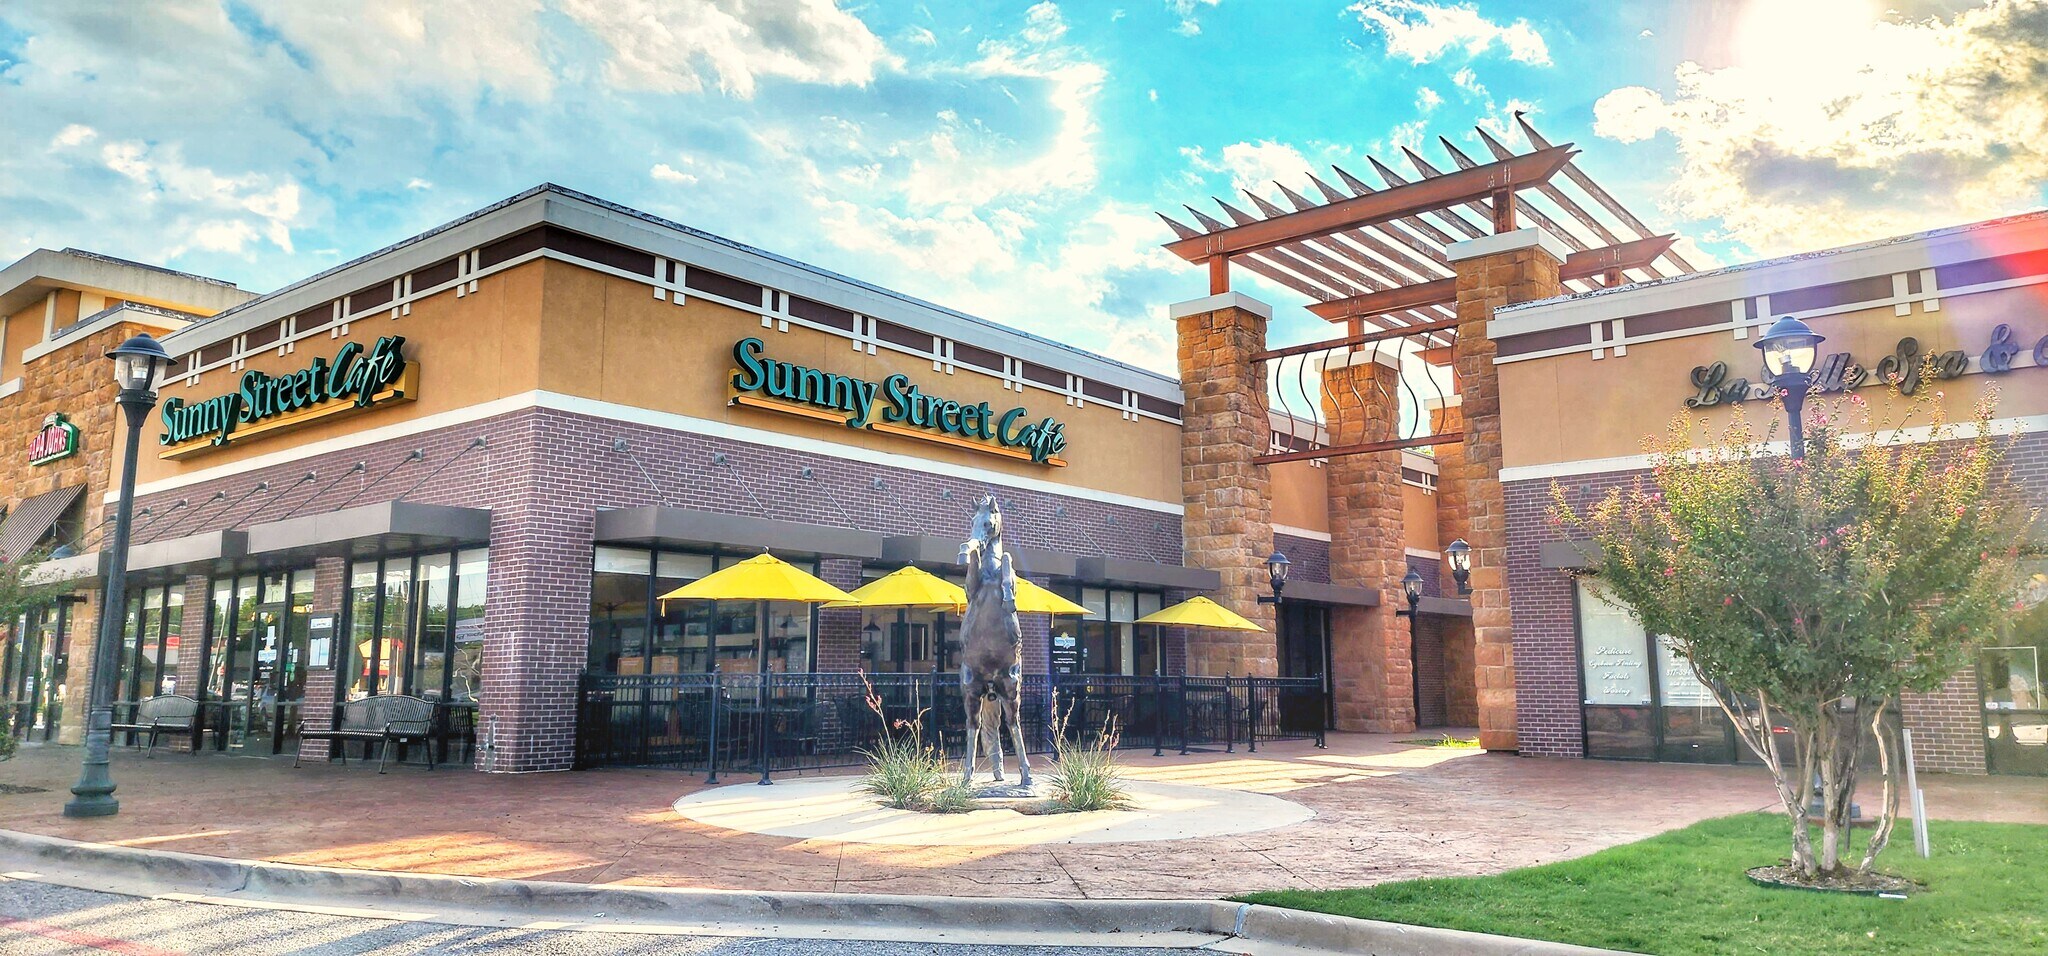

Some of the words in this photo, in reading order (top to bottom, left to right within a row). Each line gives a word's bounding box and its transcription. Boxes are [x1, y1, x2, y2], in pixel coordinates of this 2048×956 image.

[160, 396, 241, 446] Sunny
[238, 357, 329, 424] Street
[327, 335, 405, 407] Café
[733, 337, 879, 429] Sunny
[882, 373, 995, 440] Street
[997, 407, 1068, 463] Café
[1684, 360, 1750, 409] La
[1875, 337, 1969, 396] Spa
[1980, 324, 2019, 373] &
[1595, 645, 1632, 655] Pedicure
